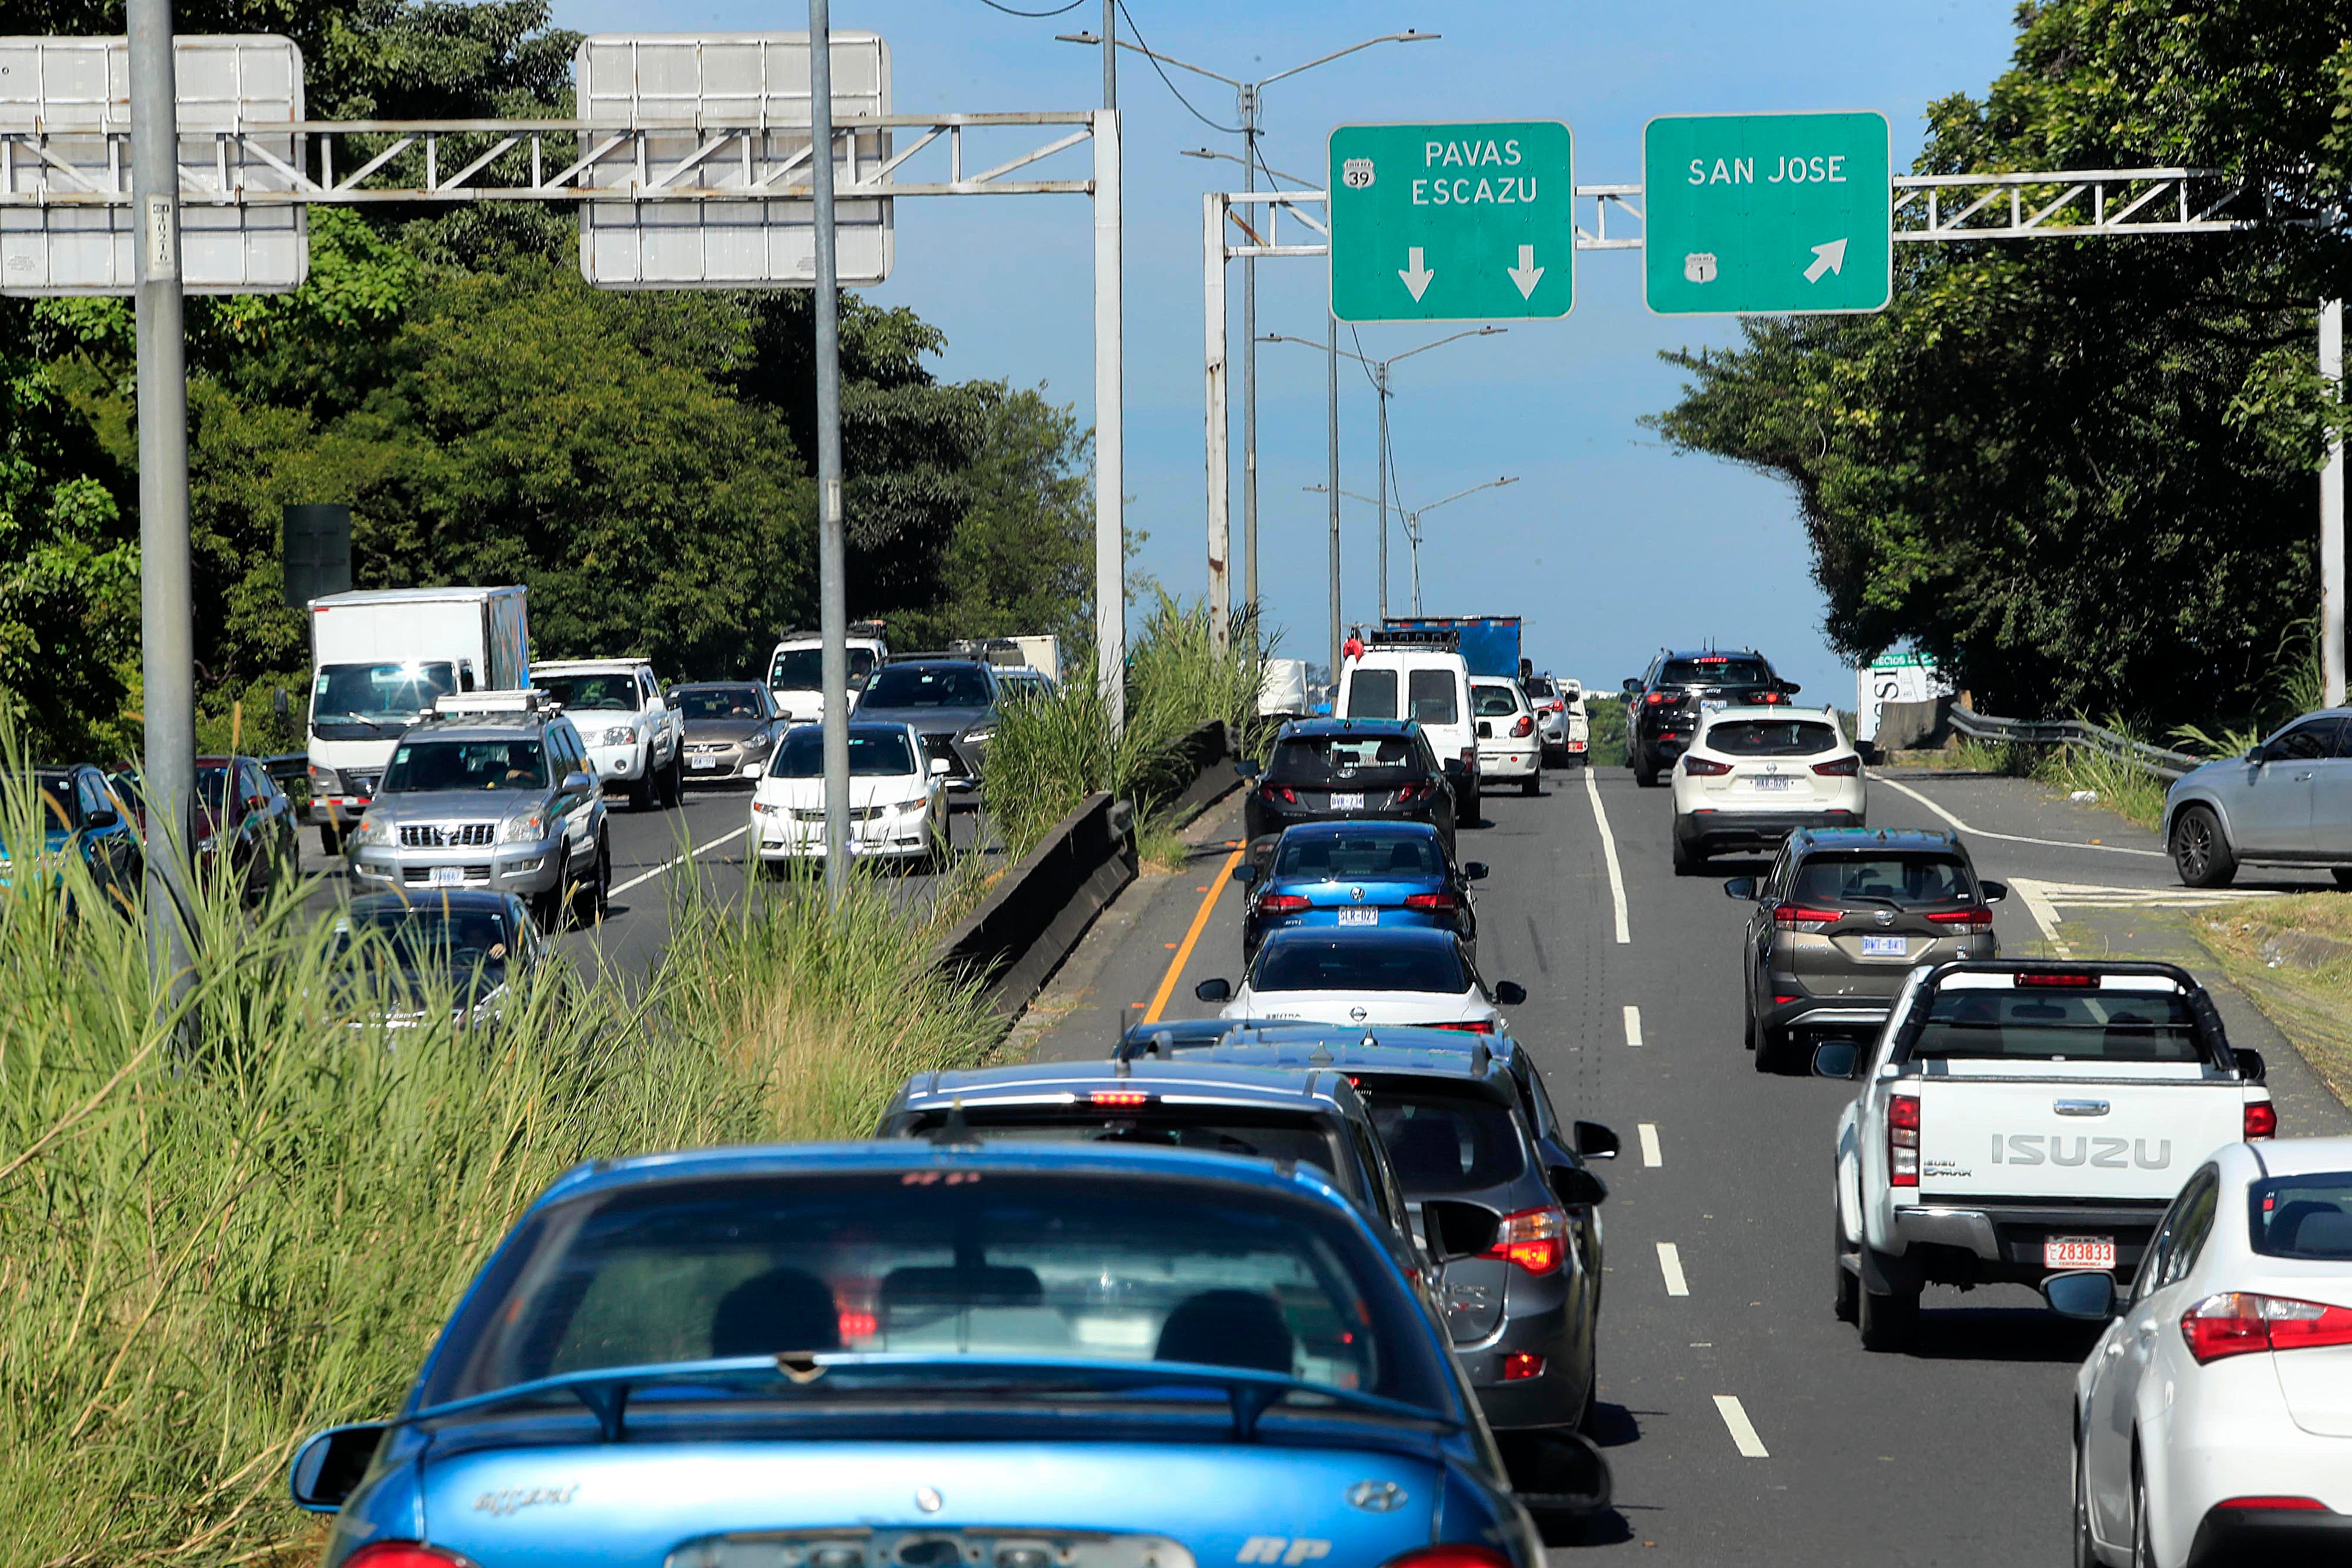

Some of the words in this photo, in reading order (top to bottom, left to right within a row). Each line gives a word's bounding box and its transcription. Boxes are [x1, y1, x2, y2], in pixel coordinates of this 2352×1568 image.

[1425, 139, 1522, 167] PAVAS
[1349, 172, 1369, 186] 39
[1688, 156, 1753, 185] SAN
[1768, 155, 1847, 183] JOSE
[1412, 177, 1537, 205] ESCAZU
[1699, 266, 1703, 280] 1
[1992, 1133, 2172, 1169] ISUZU
[2059, 1242, 2112, 1261] 283833
[1235, 1536, 1333, 1566] RP
